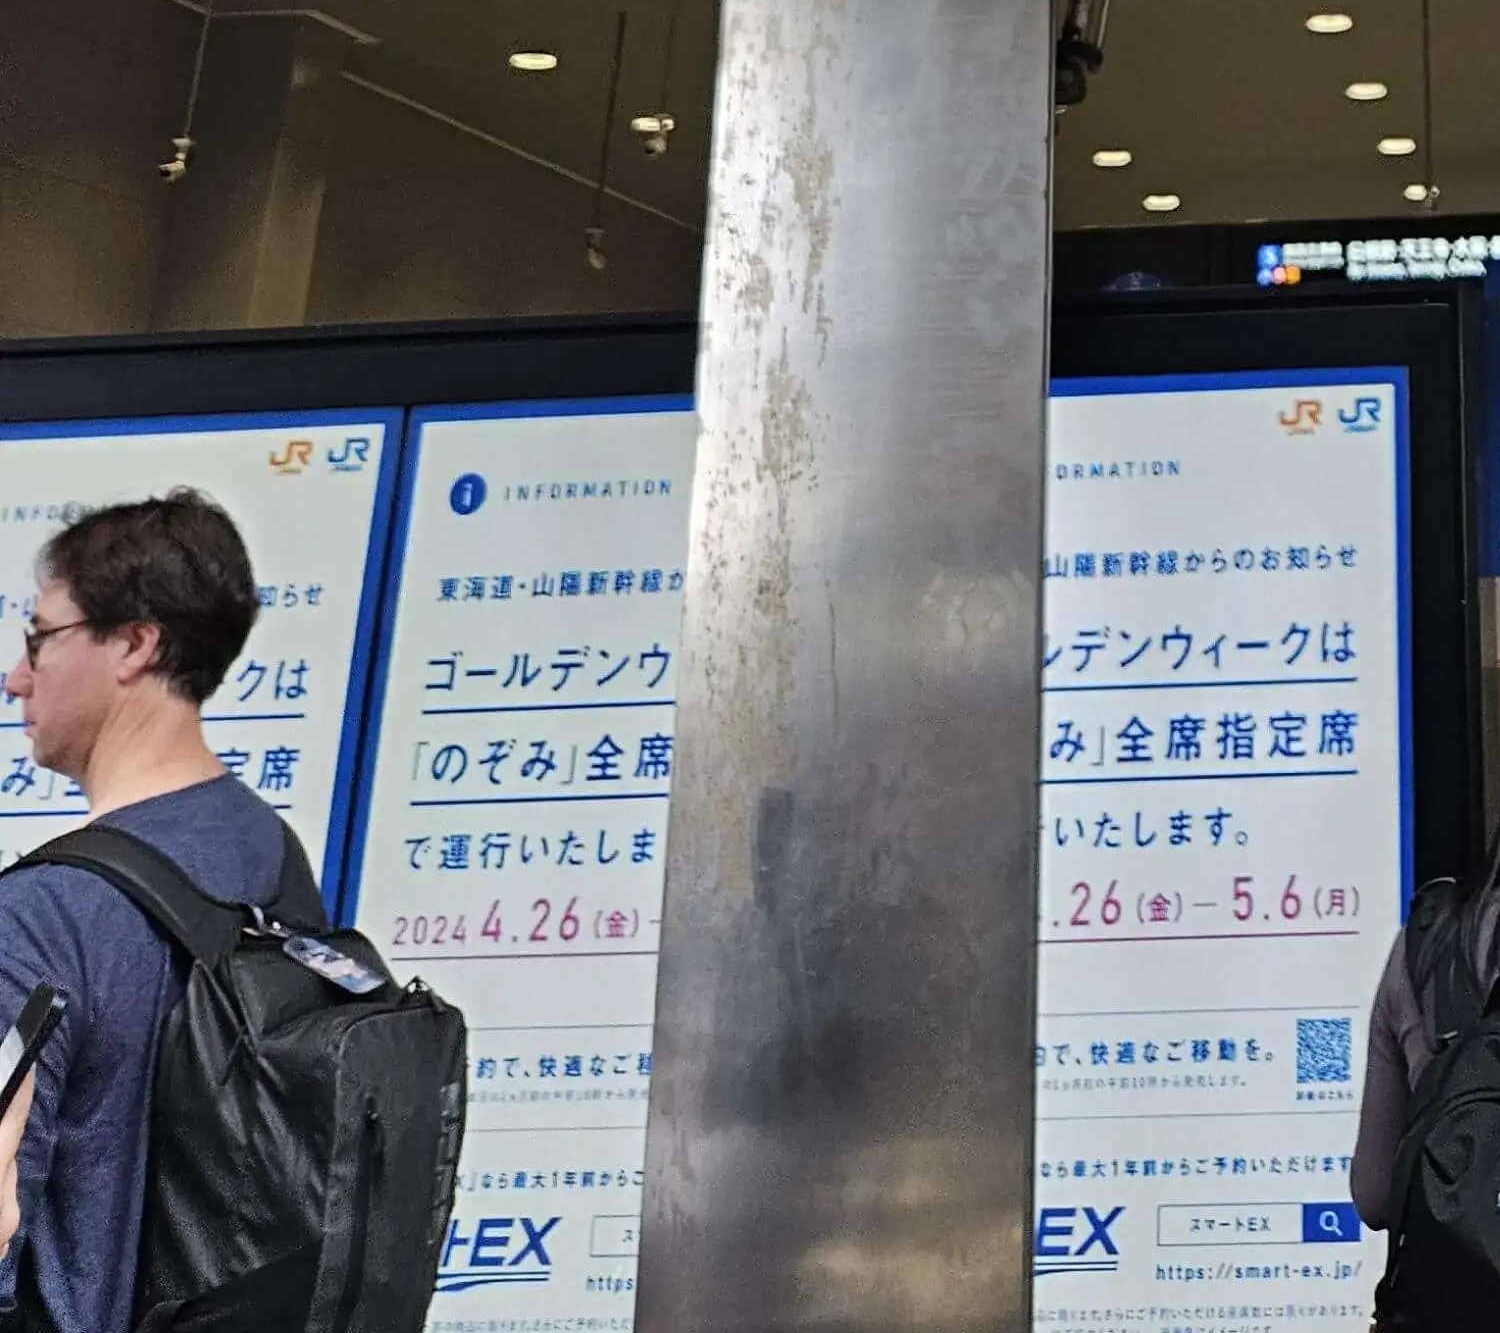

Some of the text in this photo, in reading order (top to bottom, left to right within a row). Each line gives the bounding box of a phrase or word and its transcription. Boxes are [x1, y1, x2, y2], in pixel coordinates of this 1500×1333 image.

[504, 477, 672, 503] INFORMATION
[425, 642, 671, 694] ゴールデンウ
[412, 732, 674, 787] 「のぞみ」全席
[1049, 709, 1359, 767] み」全席指定席
[404, 826, 657, 871] で運行いたしま
